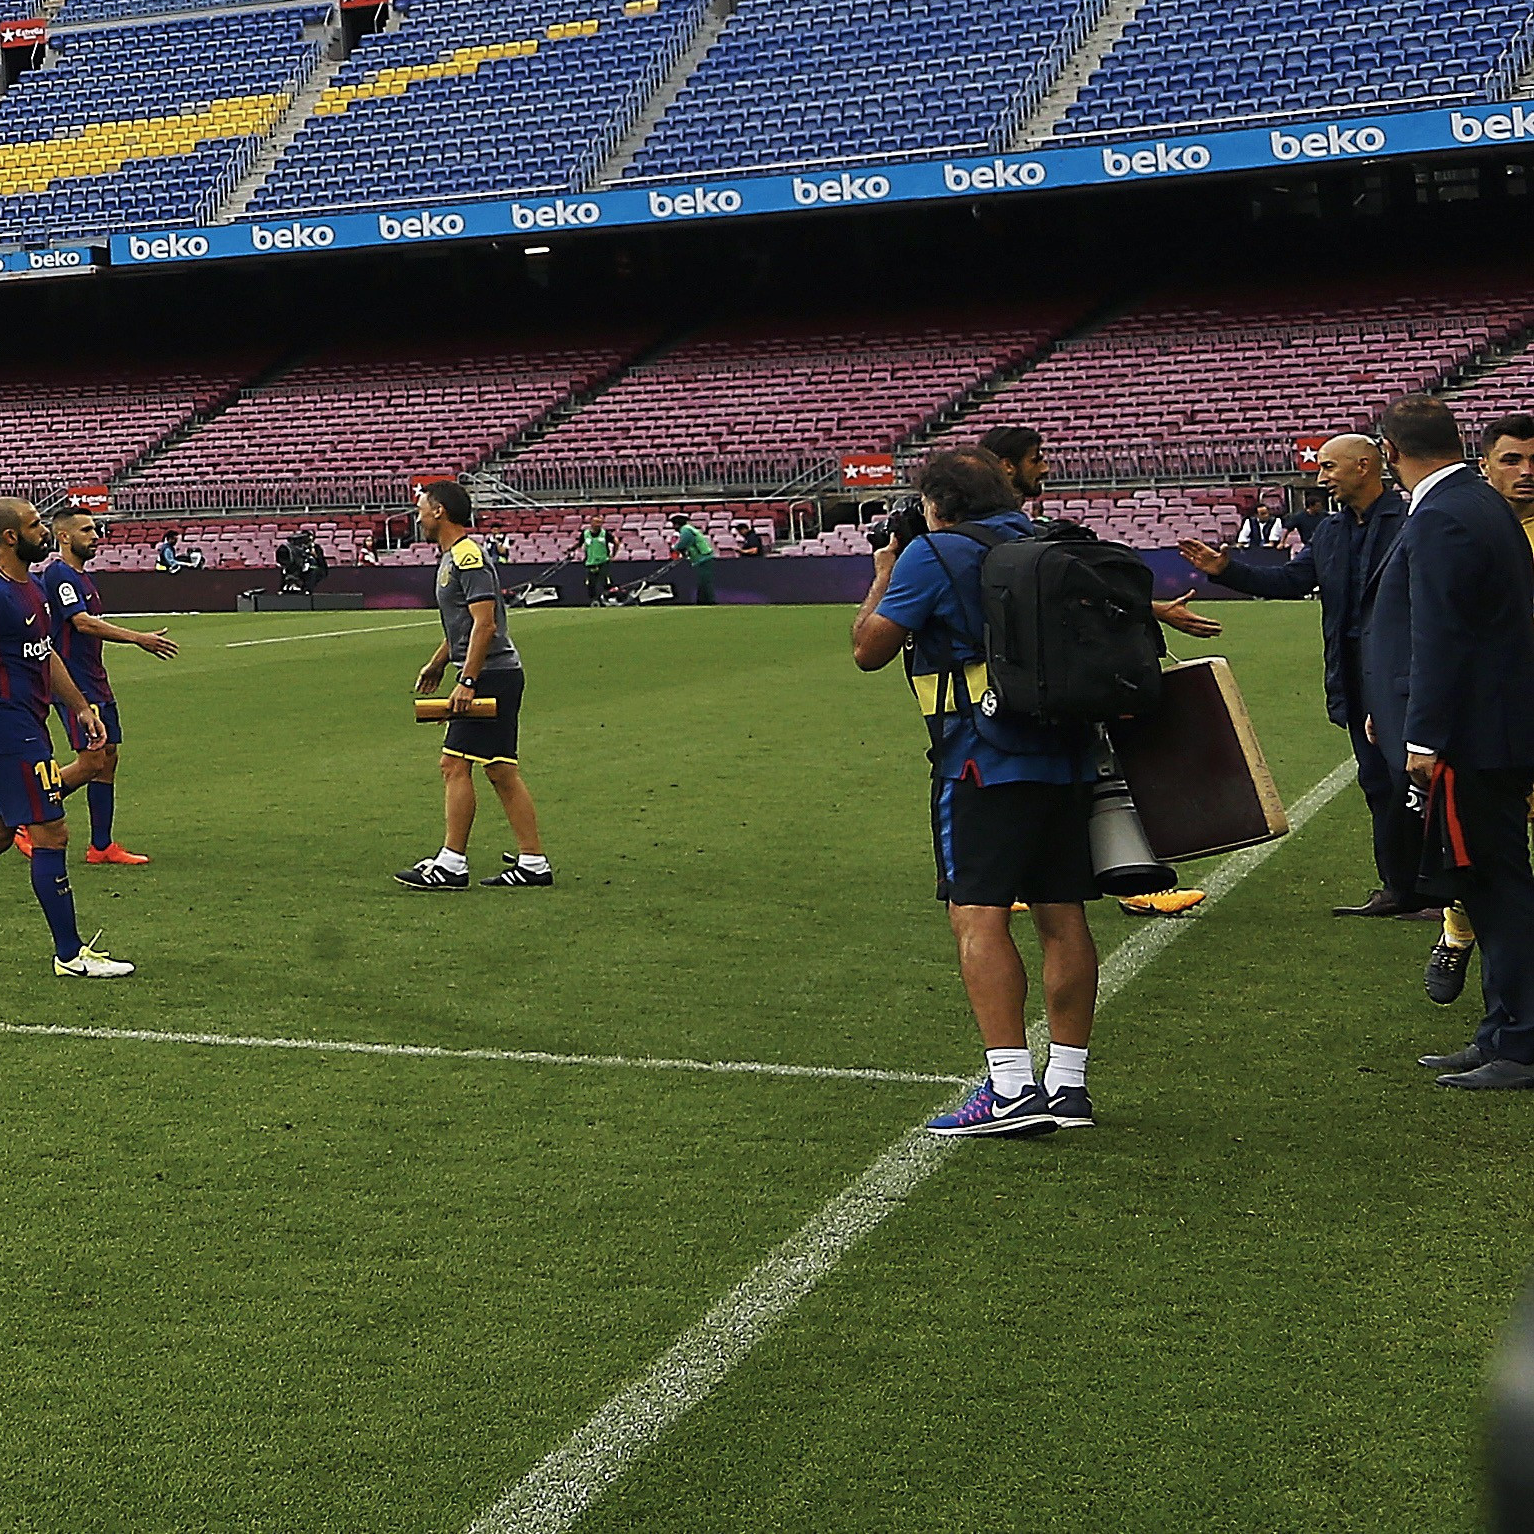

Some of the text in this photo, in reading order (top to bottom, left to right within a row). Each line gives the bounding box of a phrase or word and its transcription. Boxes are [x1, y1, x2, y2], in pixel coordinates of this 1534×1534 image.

[1450, 106, 1534, 143] bek
[1270, 124, 1386, 162] beko
[943, 158, 1047, 193] beko
[1101, 141, 1212, 179] beko
[648, 187, 742, 219] beko
[791, 172, 891, 207] beko
[377, 210, 465, 242] beko
[510, 199, 601, 230] beko
[129, 231, 210, 261] beko
[251, 222, 335, 252] beko
[29, 247, 81, 270] beko
[34, 760, 62, 790] 14
